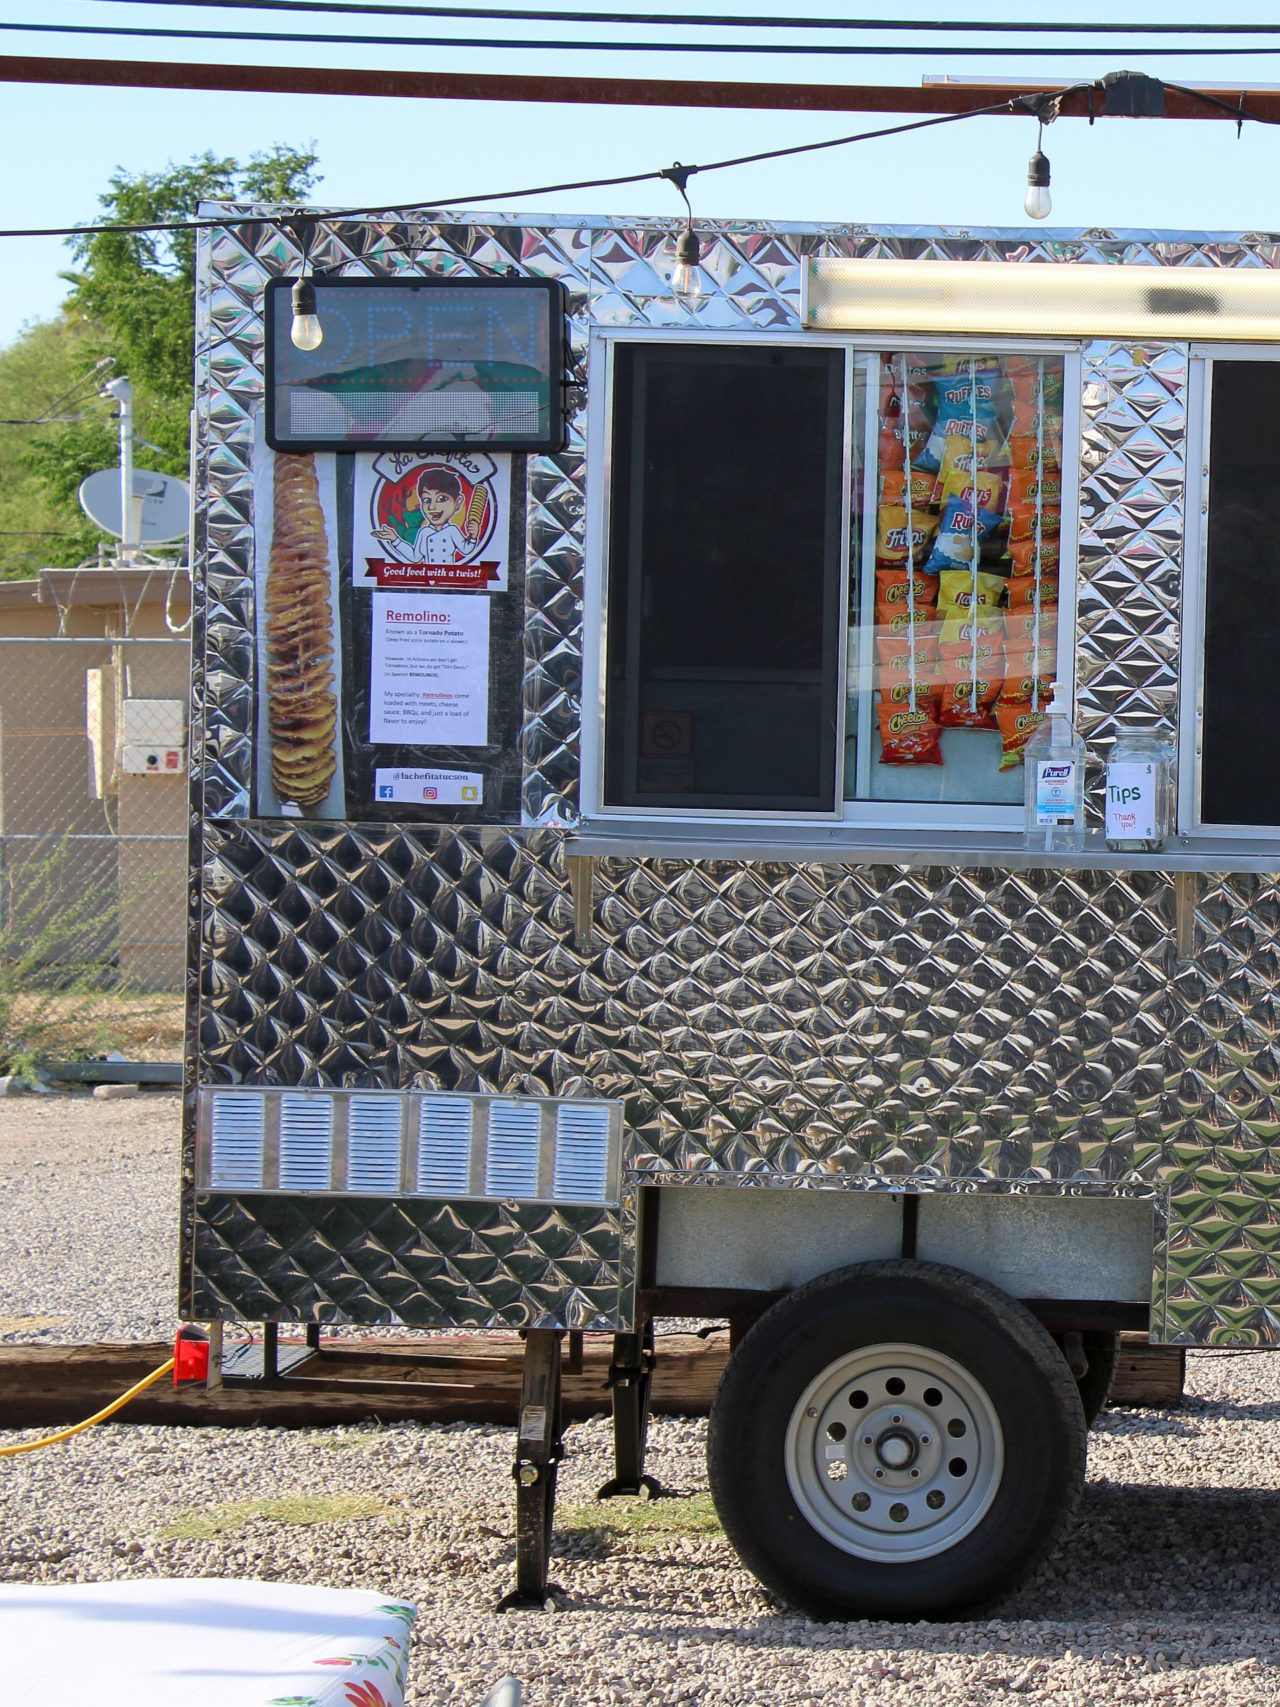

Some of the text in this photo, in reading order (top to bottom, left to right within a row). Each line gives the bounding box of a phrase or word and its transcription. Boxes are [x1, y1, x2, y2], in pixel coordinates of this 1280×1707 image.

[299, 305, 536, 368] OPEN
[945, 385, 991, 404] RUFFES
[384, 566, 405, 577] Good
[406, 567, 425, 577] food
[427, 568, 446, 577] with
[456, 569, 481, 578] twist!
[386, 610, 451, 622] Remolino:
[1109, 785, 1141, 804] Tips
